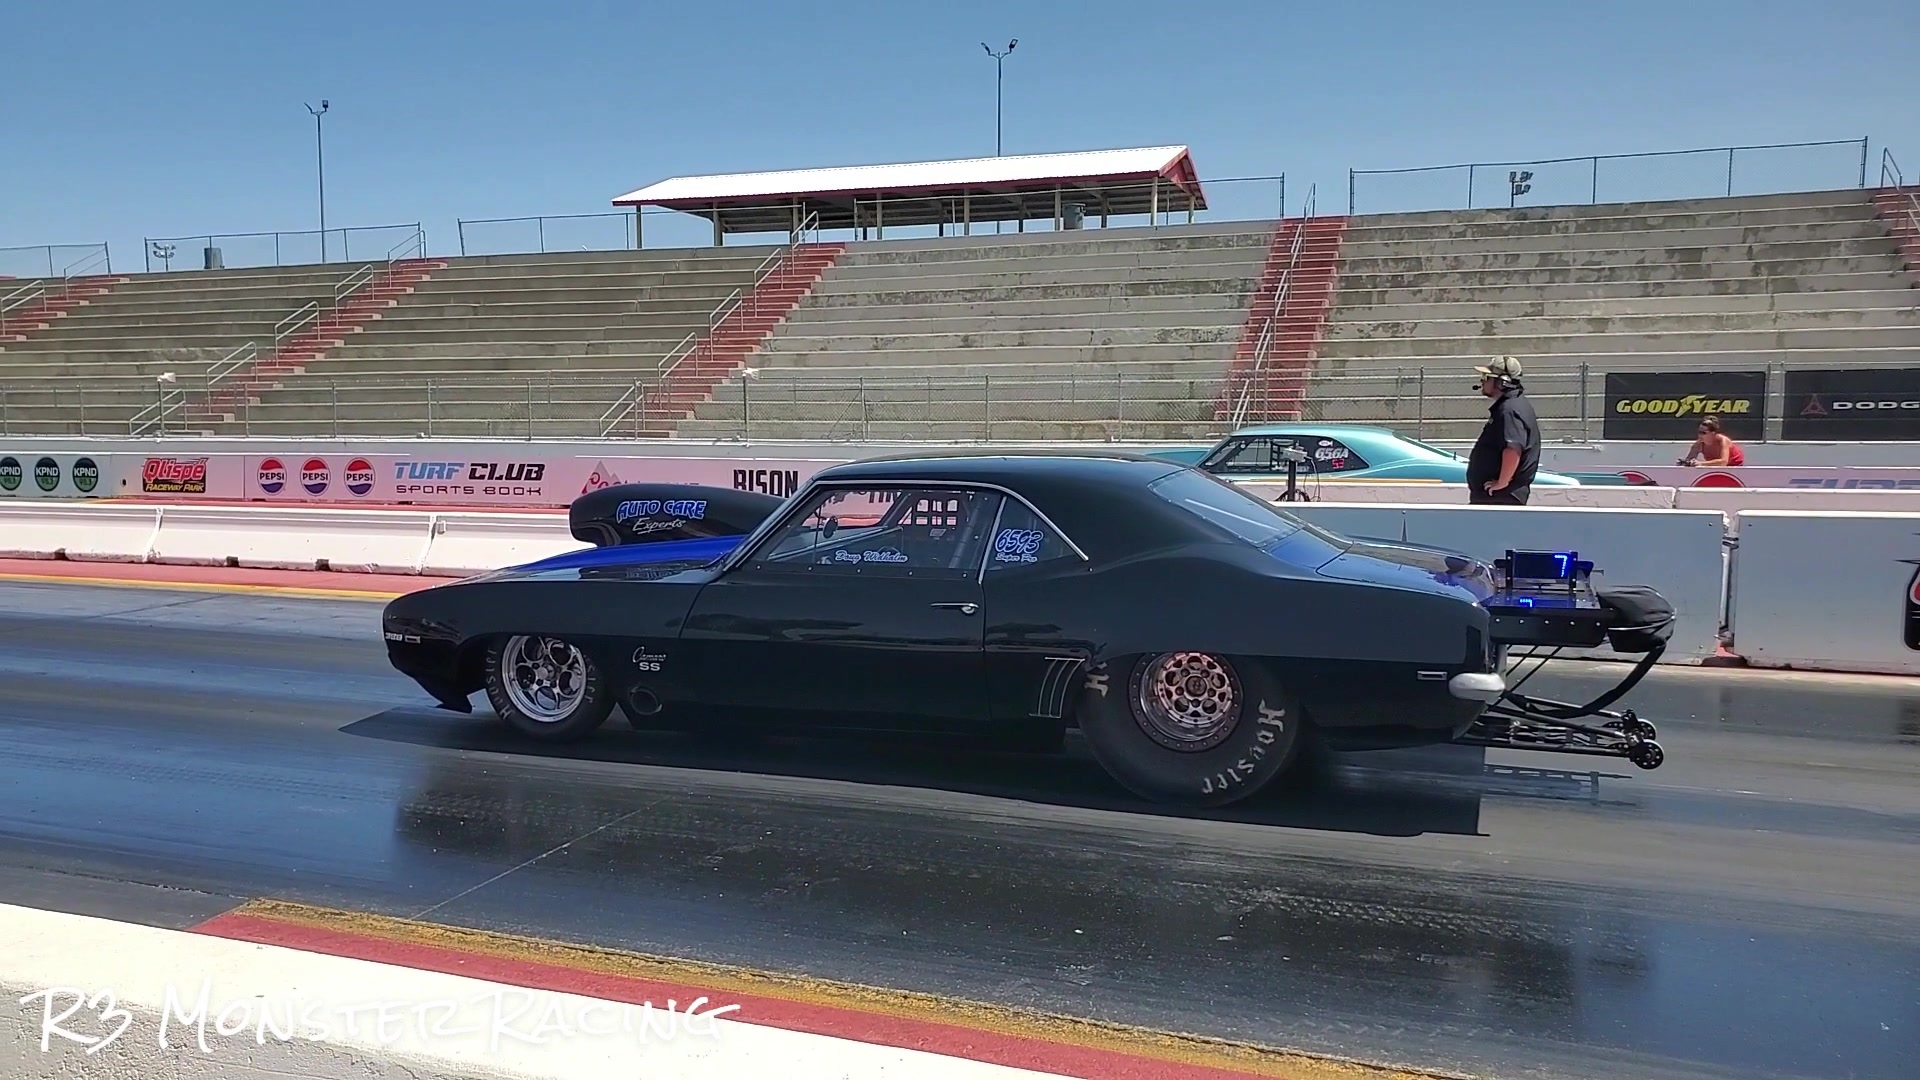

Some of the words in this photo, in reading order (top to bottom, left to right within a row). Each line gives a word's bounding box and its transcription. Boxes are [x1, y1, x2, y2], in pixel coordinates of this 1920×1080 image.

[1616, 397, 1750, 416] GOODYEAR
[35, 467, 59, 476] KPND
[73, 467, 97, 477] KPND
[259, 472, 285, 481] PEPSI
[302, 472, 329, 482] PEPSI
[346, 473, 373, 482] PEPSI
[394, 462, 465, 480] TURF
[468, 463, 546, 481] CLUB
[145, 483, 183, 492] RACEWAY
[183, 483, 204, 492] PARK
[396, 484, 475, 495] SPORTS
[482, 486, 542, 496] BOOK
[733, 469, 798, 498] BISON
[616, 500, 658, 524] AUTO
[663, 500, 707, 519] CARE
[632, 517, 687, 532] Experts
[995, 529, 1044, 553] 6593
[835, 549, 862, 565] Doug
[639, 661, 661, 671] SS
[1202, 698, 1286, 794] Hoosier
